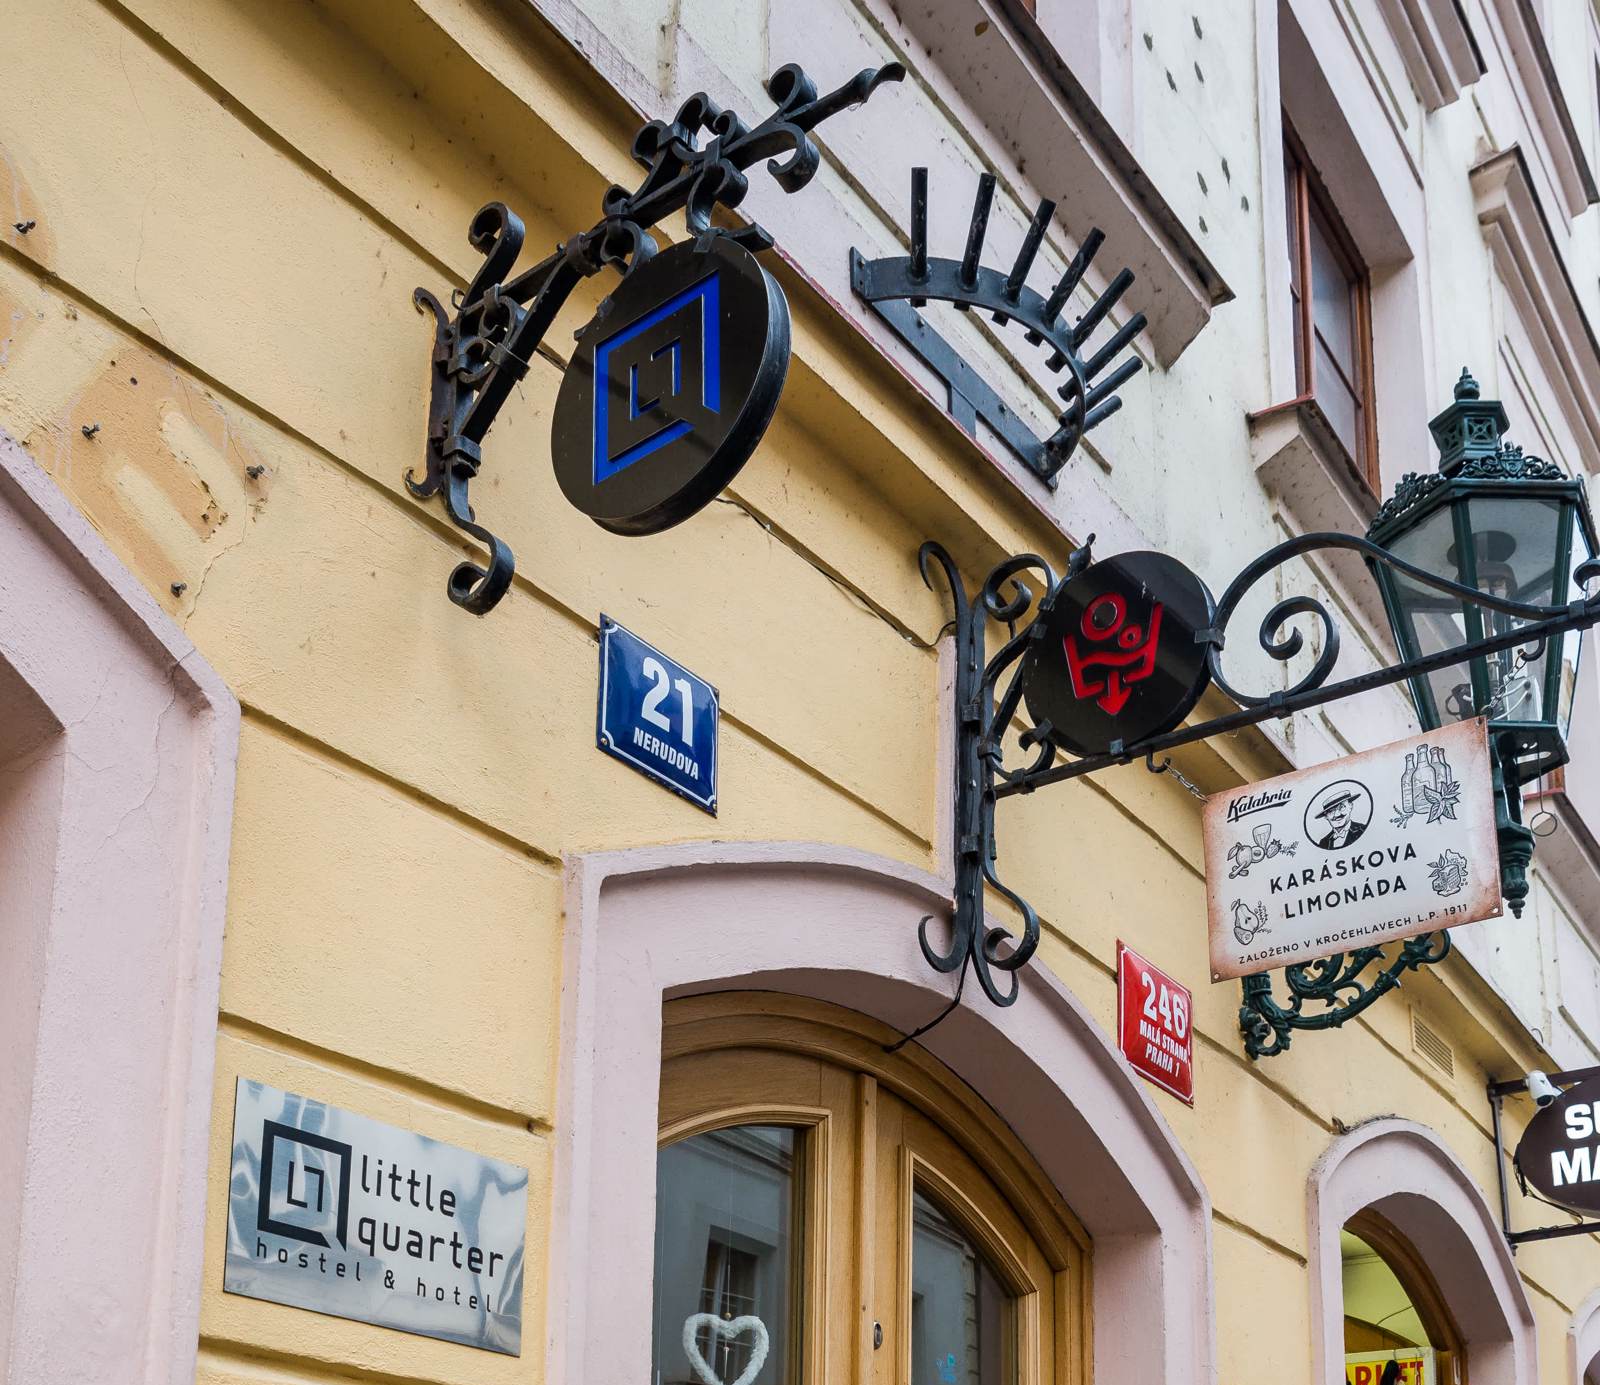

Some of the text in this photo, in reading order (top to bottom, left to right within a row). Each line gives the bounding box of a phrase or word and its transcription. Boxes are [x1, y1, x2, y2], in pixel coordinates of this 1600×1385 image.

[641, 656, 694, 748] 21
[633, 726, 700, 781] NERUDOVA
[1270, 842, 1417, 894] KARÁSKOVA
[1284, 875, 1407, 920] LIMONÁDA
[1239, 903, 1468, 965] ZALOŽENO V KROČEHLAVECH L.P. 1911
[1141, 971, 1187, 1040] 246
[1139, 1018, 1188, 1064] MALÁ STRANA
[1145, 1043, 1181, 1078] PRAHA 1
[1564, 1099, 1600, 1140] S
[361, 1154, 457, 1218] little
[1551, 1145, 1600, 1187] M
[256, 1237, 491, 1312] hostel & hotel
[358, 1216, 504, 1278] quarter
